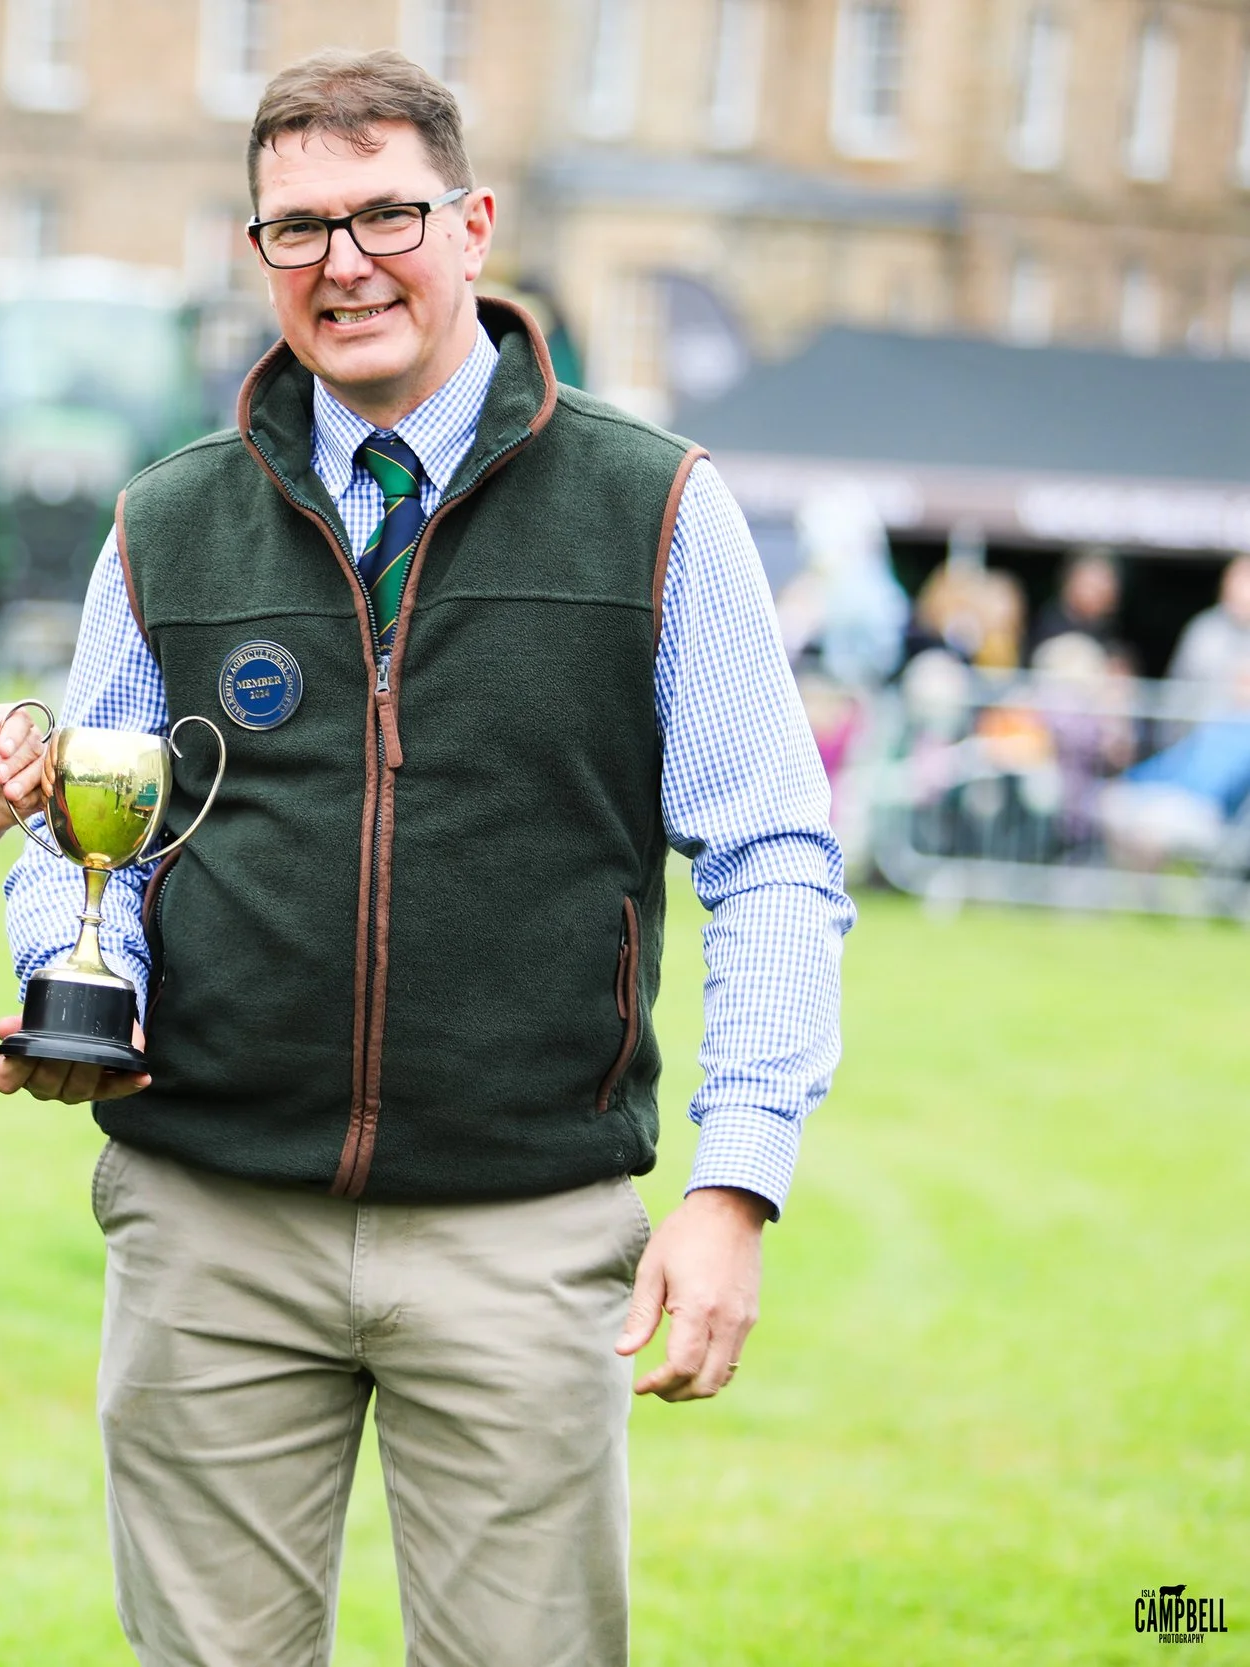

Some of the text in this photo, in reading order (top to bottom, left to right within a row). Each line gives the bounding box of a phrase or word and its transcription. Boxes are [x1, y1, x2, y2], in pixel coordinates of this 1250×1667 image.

[225, 649, 294, 720] DALKEITH AGRICULTURAL SOCIETY
[236, 675, 282, 690] MEMBER
[249, 689, 270, 700] 2024
